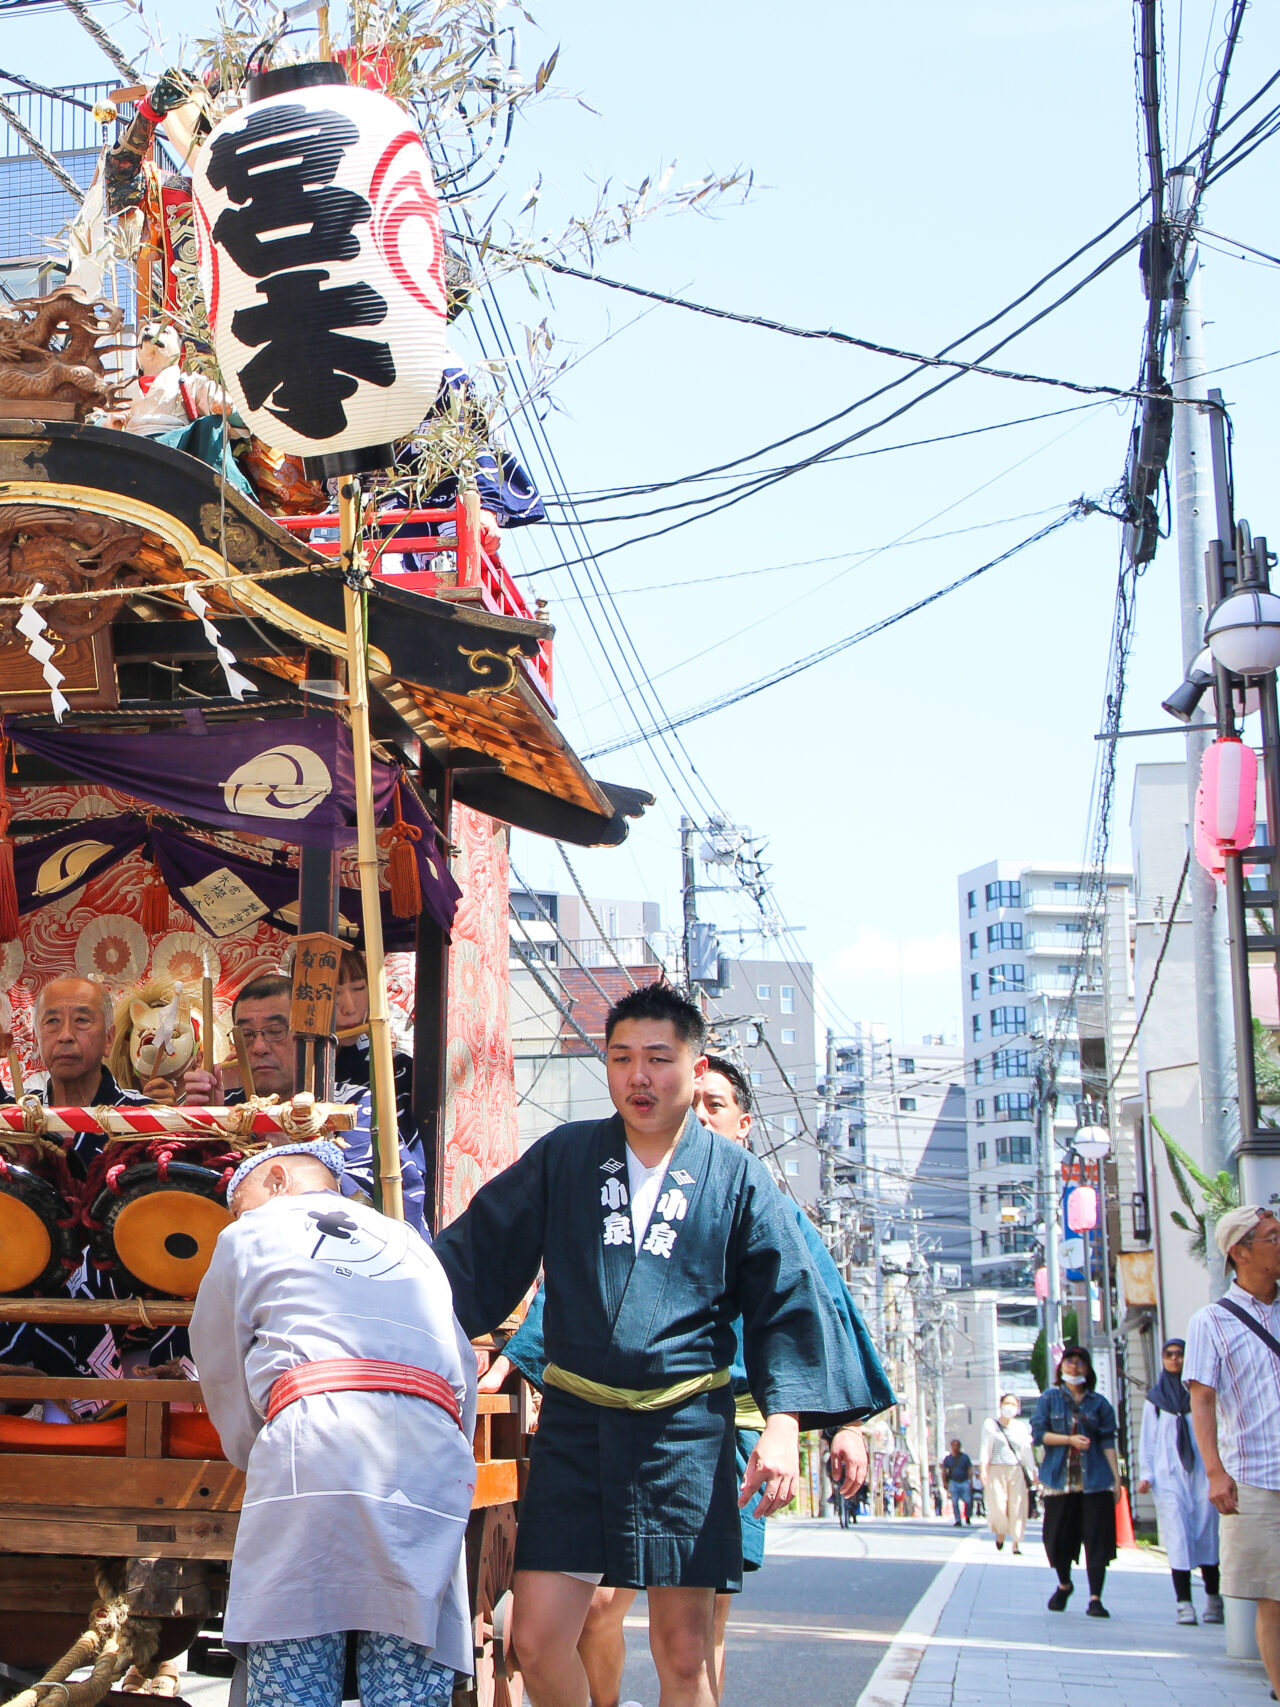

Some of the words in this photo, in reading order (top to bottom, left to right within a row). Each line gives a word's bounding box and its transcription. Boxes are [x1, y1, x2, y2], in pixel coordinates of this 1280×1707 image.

[206, 104, 396, 440] 宮本
[601, 1177, 632, 1245] 小泉
[643, 1189, 687, 1258] 小泉
